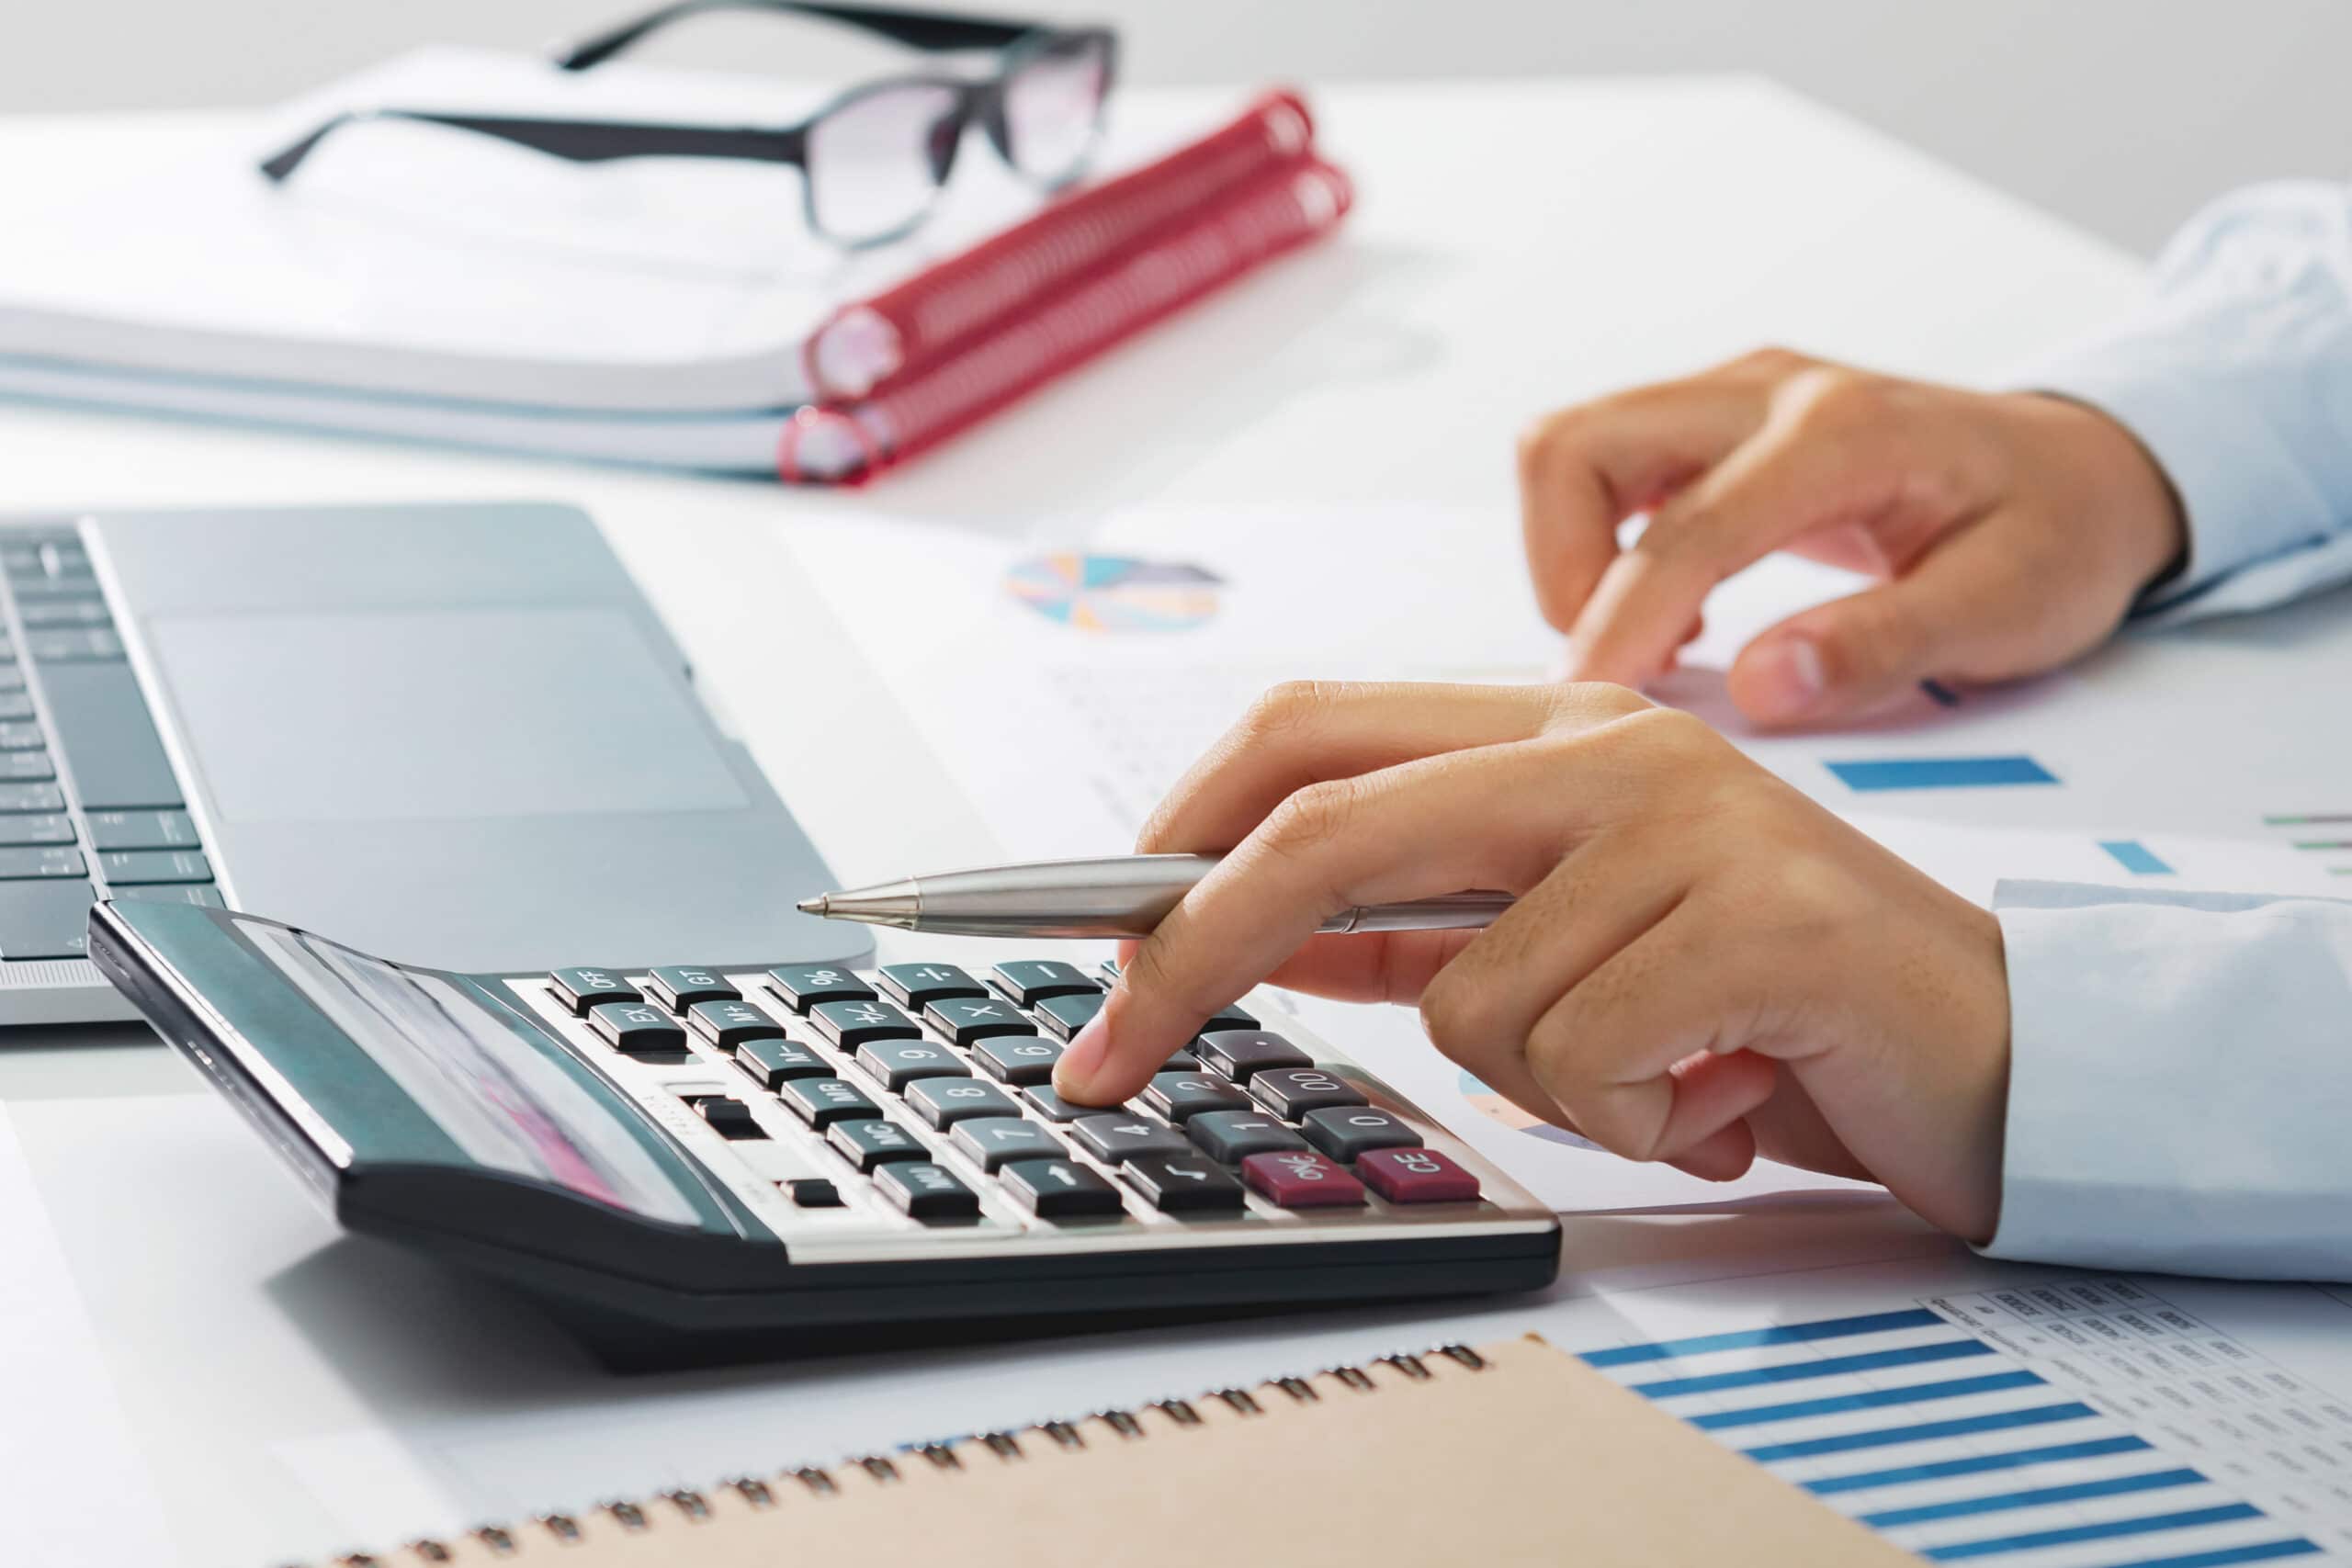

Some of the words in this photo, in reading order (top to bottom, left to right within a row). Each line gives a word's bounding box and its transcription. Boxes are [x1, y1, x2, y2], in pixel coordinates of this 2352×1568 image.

[577, 971, 616, 988] OFF
[678, 970, 715, 986] GT
[804, 970, 843, 986] %
[619, 1009, 660, 1022] EX
[724, 1005, 760, 1022] M+
[899, 1049, 938, 1059] 9
[1013, 1046, 1052, 1055] 6
[1176, 1081, 1220, 1091] 2
[1288, 1073, 1340, 1090] 00
[818, 1083, 859, 1102] MR
[946, 1088, 986, 1098] 8
[1349, 1116, 1389, 1126] 0
[863, 1123, 907, 1145] MC
[991, 1128, 1035, 1140] 7
[1113, 1124, 1150, 1135] 4
[1393, 1153, 1442, 1173] CE
